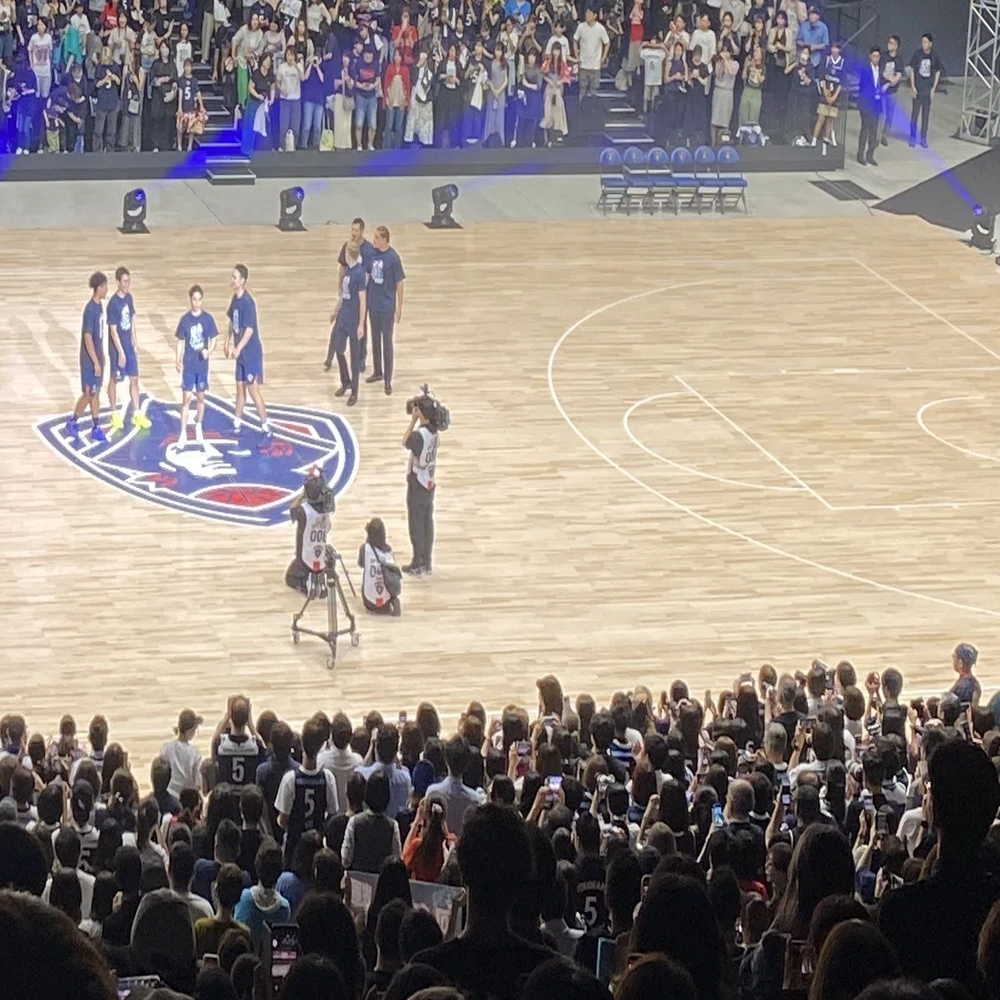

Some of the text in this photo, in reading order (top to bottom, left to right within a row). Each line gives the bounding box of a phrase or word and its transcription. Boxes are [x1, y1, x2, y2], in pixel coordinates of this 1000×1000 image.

[184, 87, 191, 100] 5
[232, 757, 245, 782] 5
[304, 789, 315, 818] 5
[584, 896, 597, 926] 5
